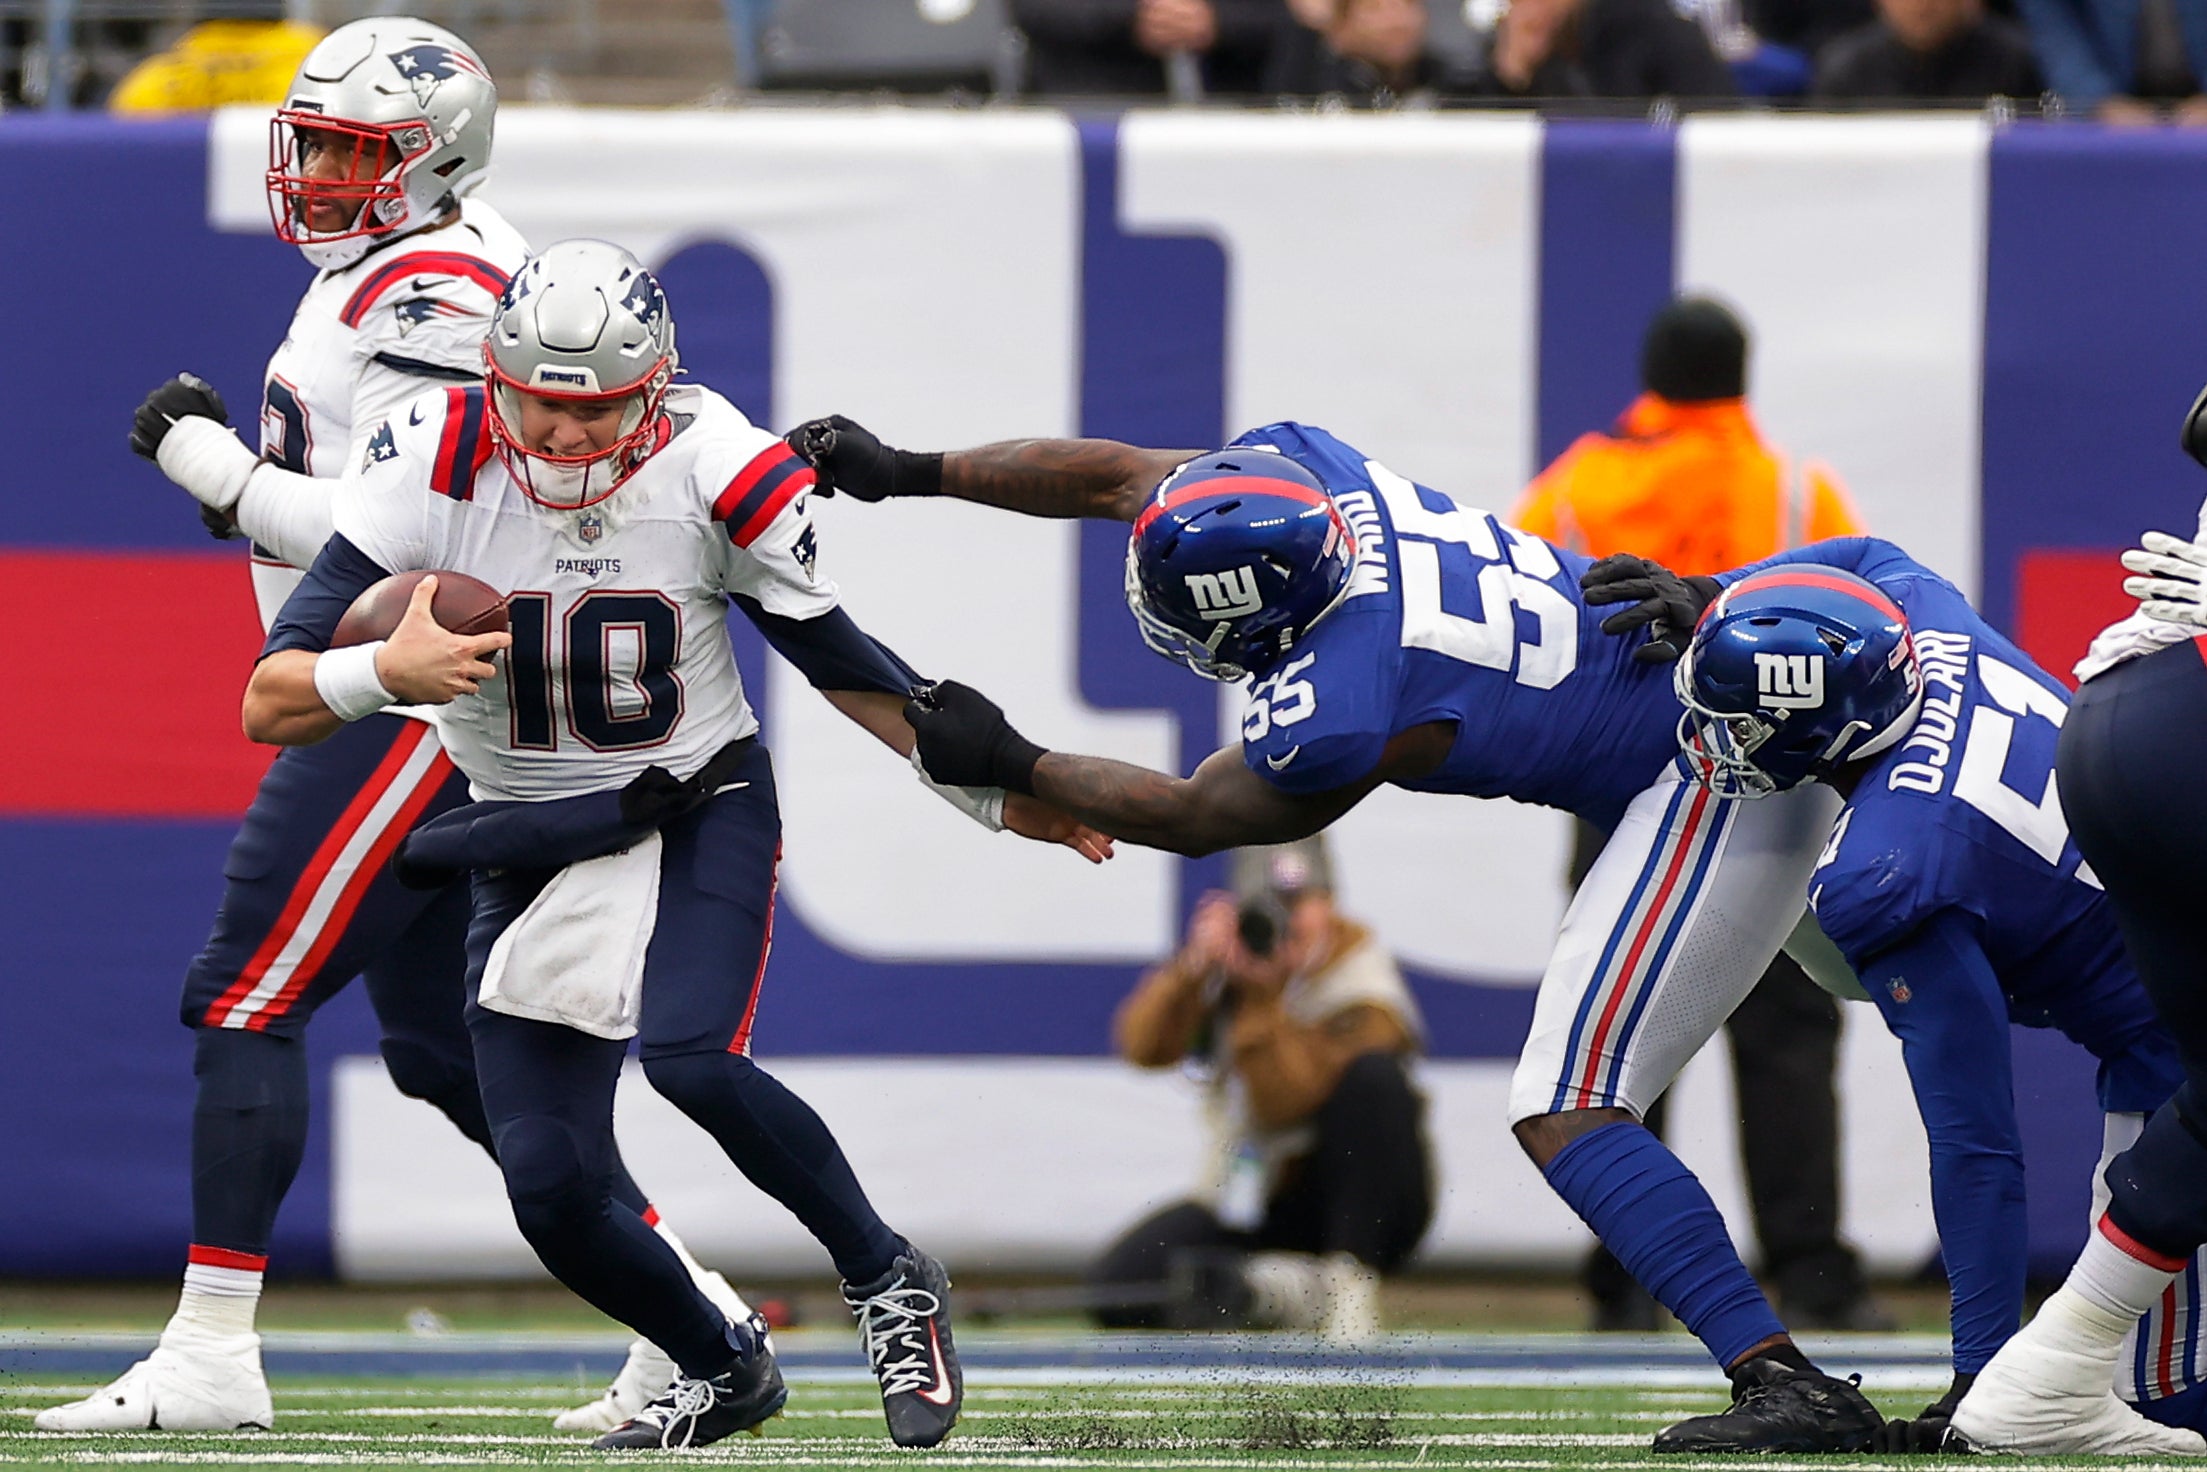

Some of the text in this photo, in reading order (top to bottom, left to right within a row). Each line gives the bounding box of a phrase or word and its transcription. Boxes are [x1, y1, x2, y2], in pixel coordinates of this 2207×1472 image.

[555, 559, 621, 574] PATRIOTS
[1334, 489, 1389, 601] WARD
[1363, 459, 1579, 691] 55
[1184, 565, 1264, 620] ny
[503, 589, 685, 754] 10
[1244, 651, 1316, 742] 55
[1754, 652, 1824, 709] ny
